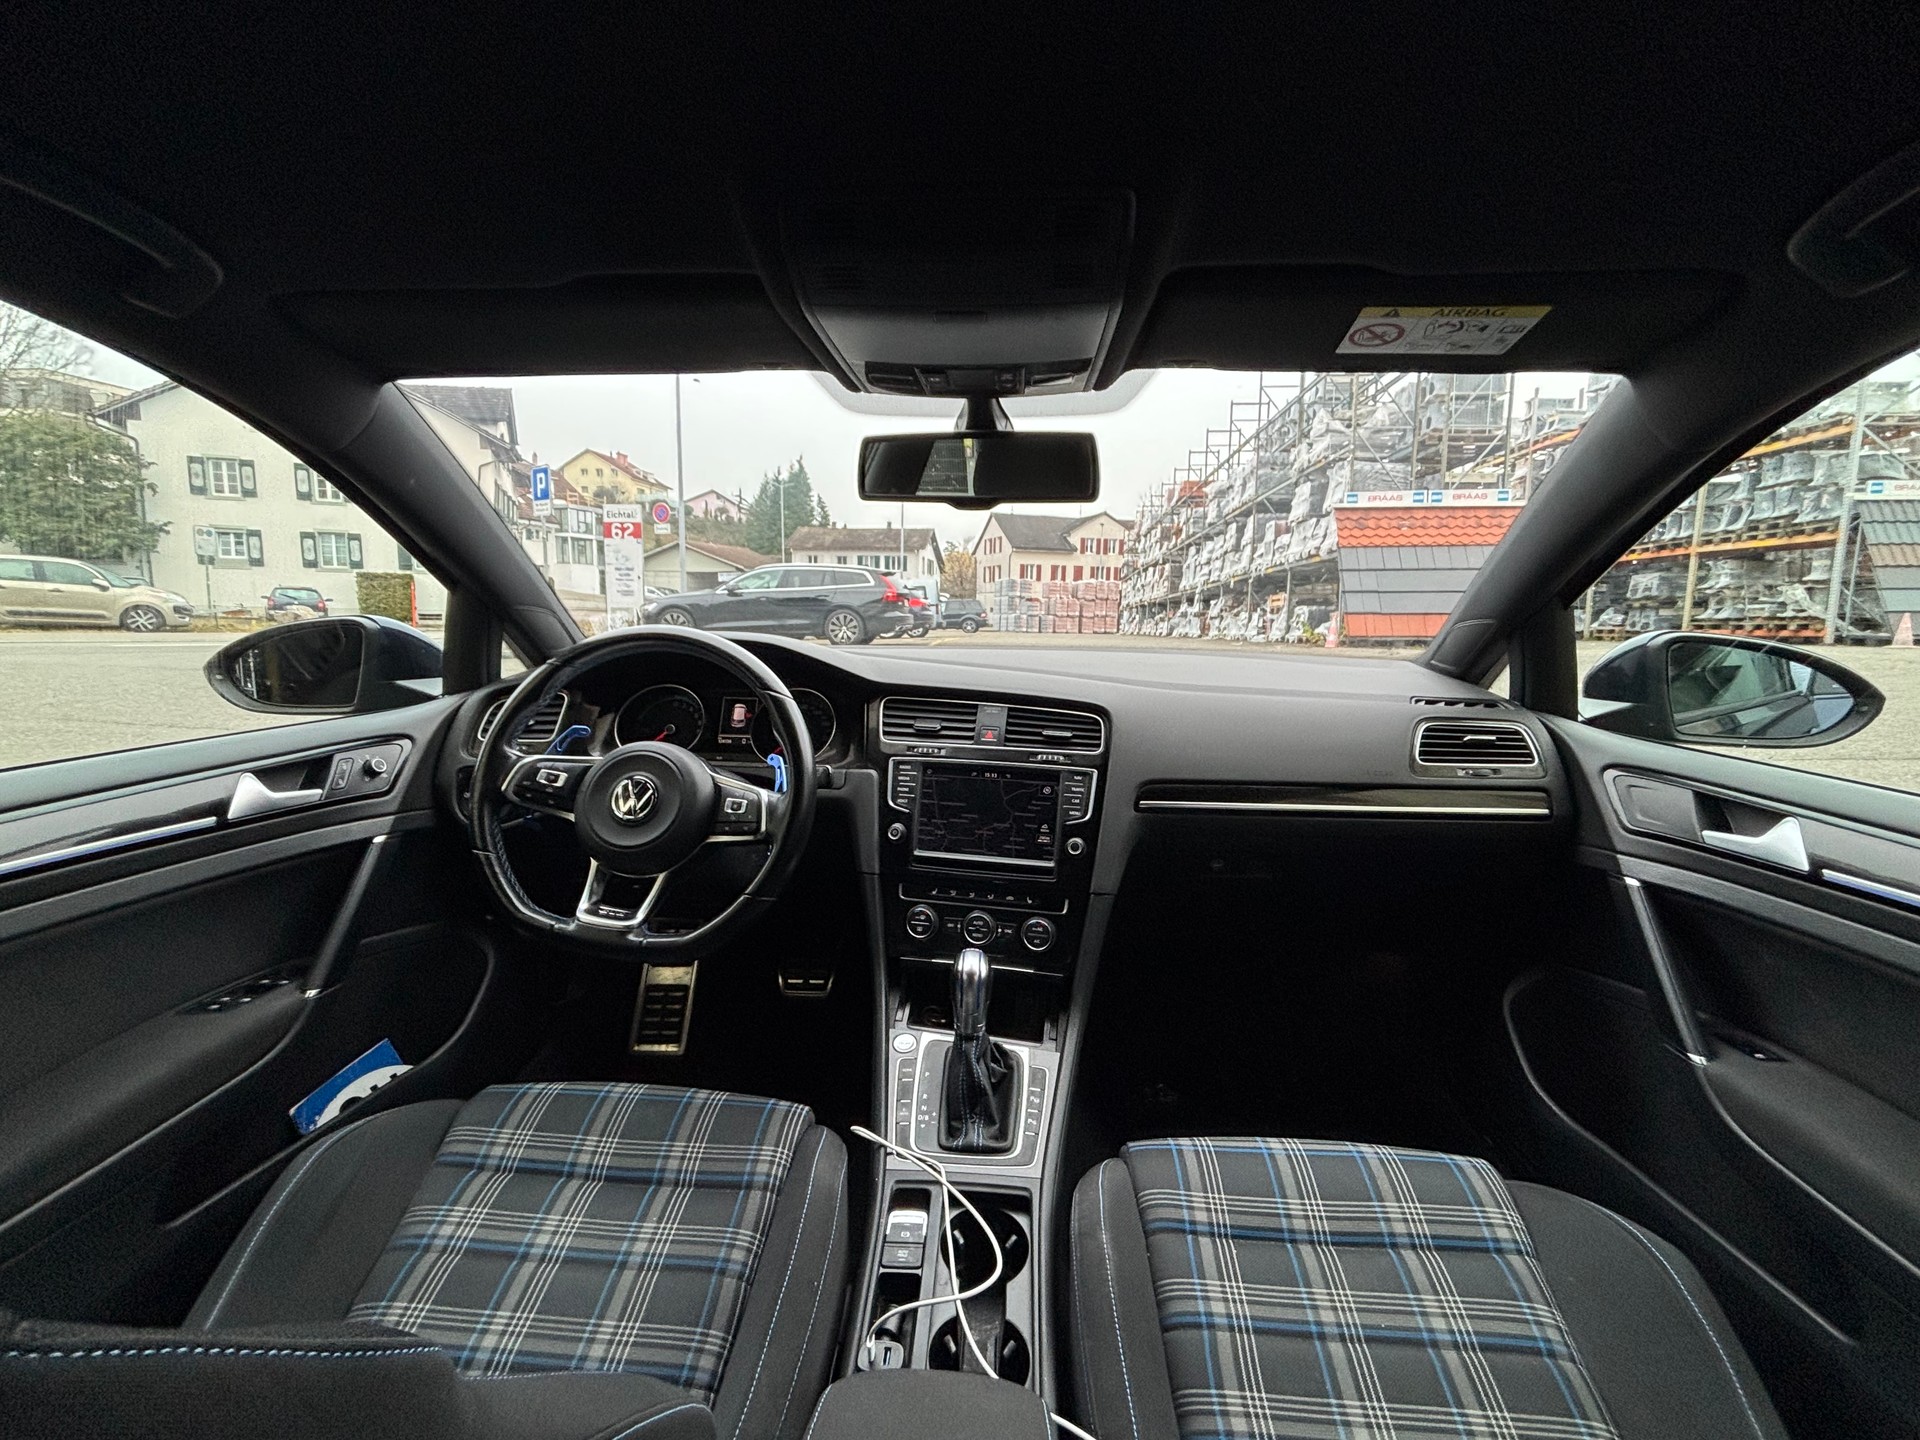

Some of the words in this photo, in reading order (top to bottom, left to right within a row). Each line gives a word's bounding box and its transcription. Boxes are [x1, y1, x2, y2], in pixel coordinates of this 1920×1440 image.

[1430, 307, 1507, 317] AIRBAG
[536, 472, 546, 498] P
[1368, 493, 1403, 502] BRAAS
[1452, 492, 1488, 500] BRAAS
[611, 522, 634, 539] 62
